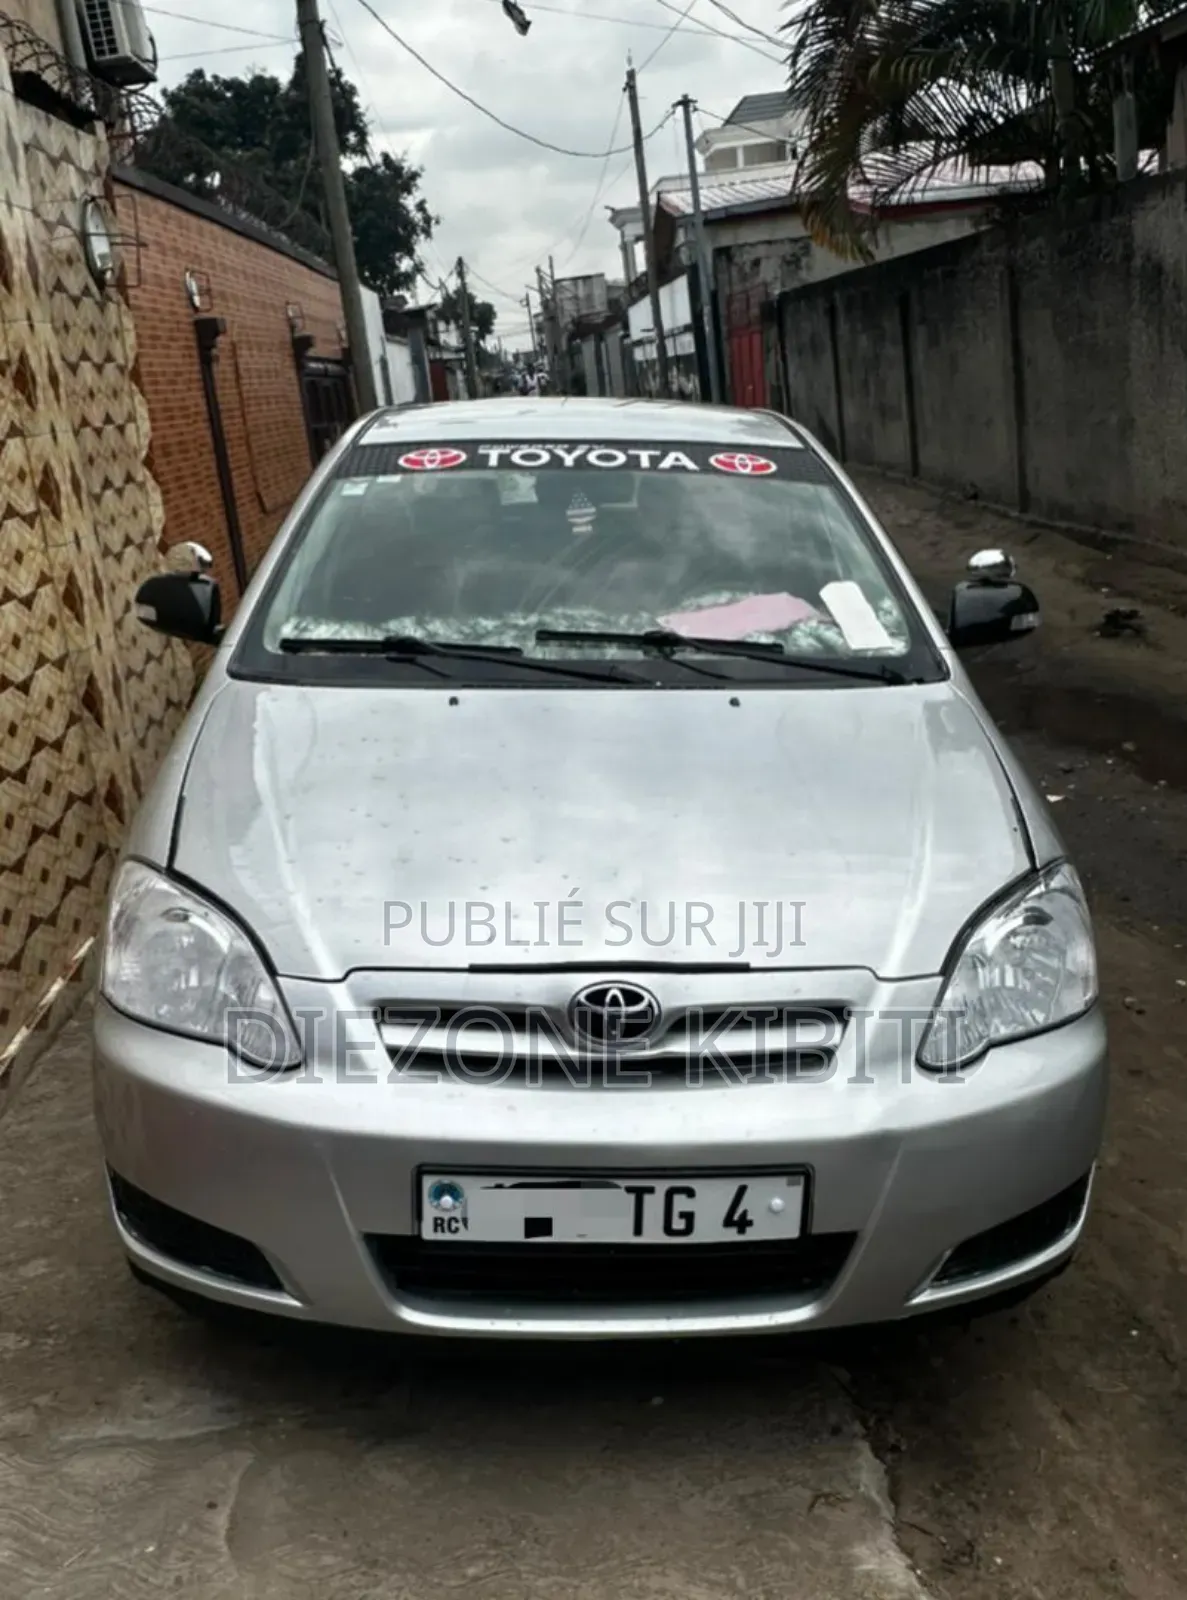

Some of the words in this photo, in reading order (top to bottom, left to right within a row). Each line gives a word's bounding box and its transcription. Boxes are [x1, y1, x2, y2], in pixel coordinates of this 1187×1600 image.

[477, 448, 700, 471] TOYOTA
[624, 1185, 697, 1237] TG
[722, 1184, 754, 1235] 4
